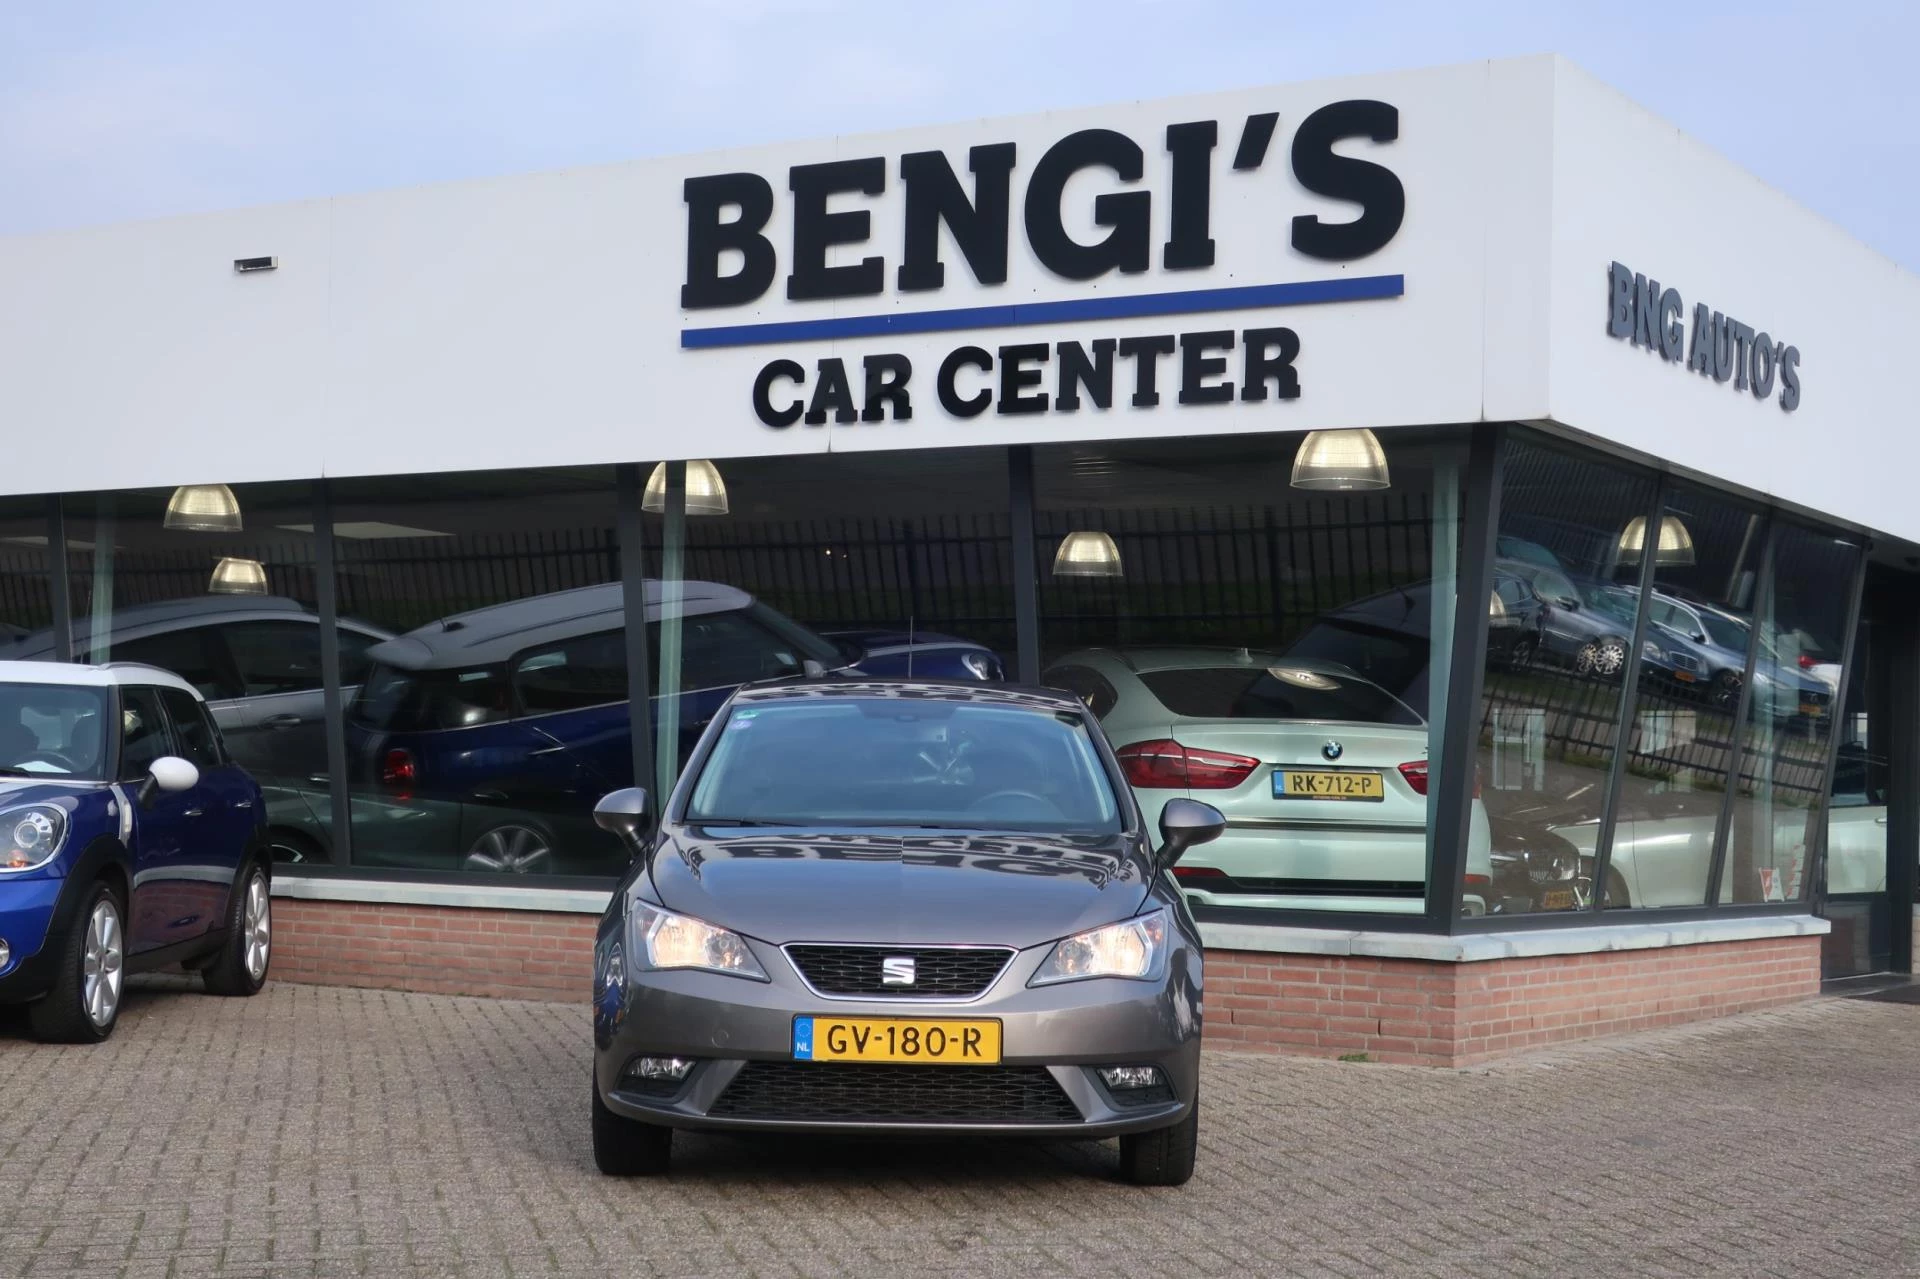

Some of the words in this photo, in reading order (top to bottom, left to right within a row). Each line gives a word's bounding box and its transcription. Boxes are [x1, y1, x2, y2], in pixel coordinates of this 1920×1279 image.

[681, 99, 1405, 309] BENGI'S
[1607, 260, 1684, 363] BNG
[1688, 302, 1800, 411] AUTO'S
[752, 353, 913, 427] CAR
[937, 327, 1301, 418] CENTER
[1292, 774, 1371, 794] RK-712-P
[796, 1042, 810, 1052] NL
[827, 1024, 981, 1057] GV-180-R
